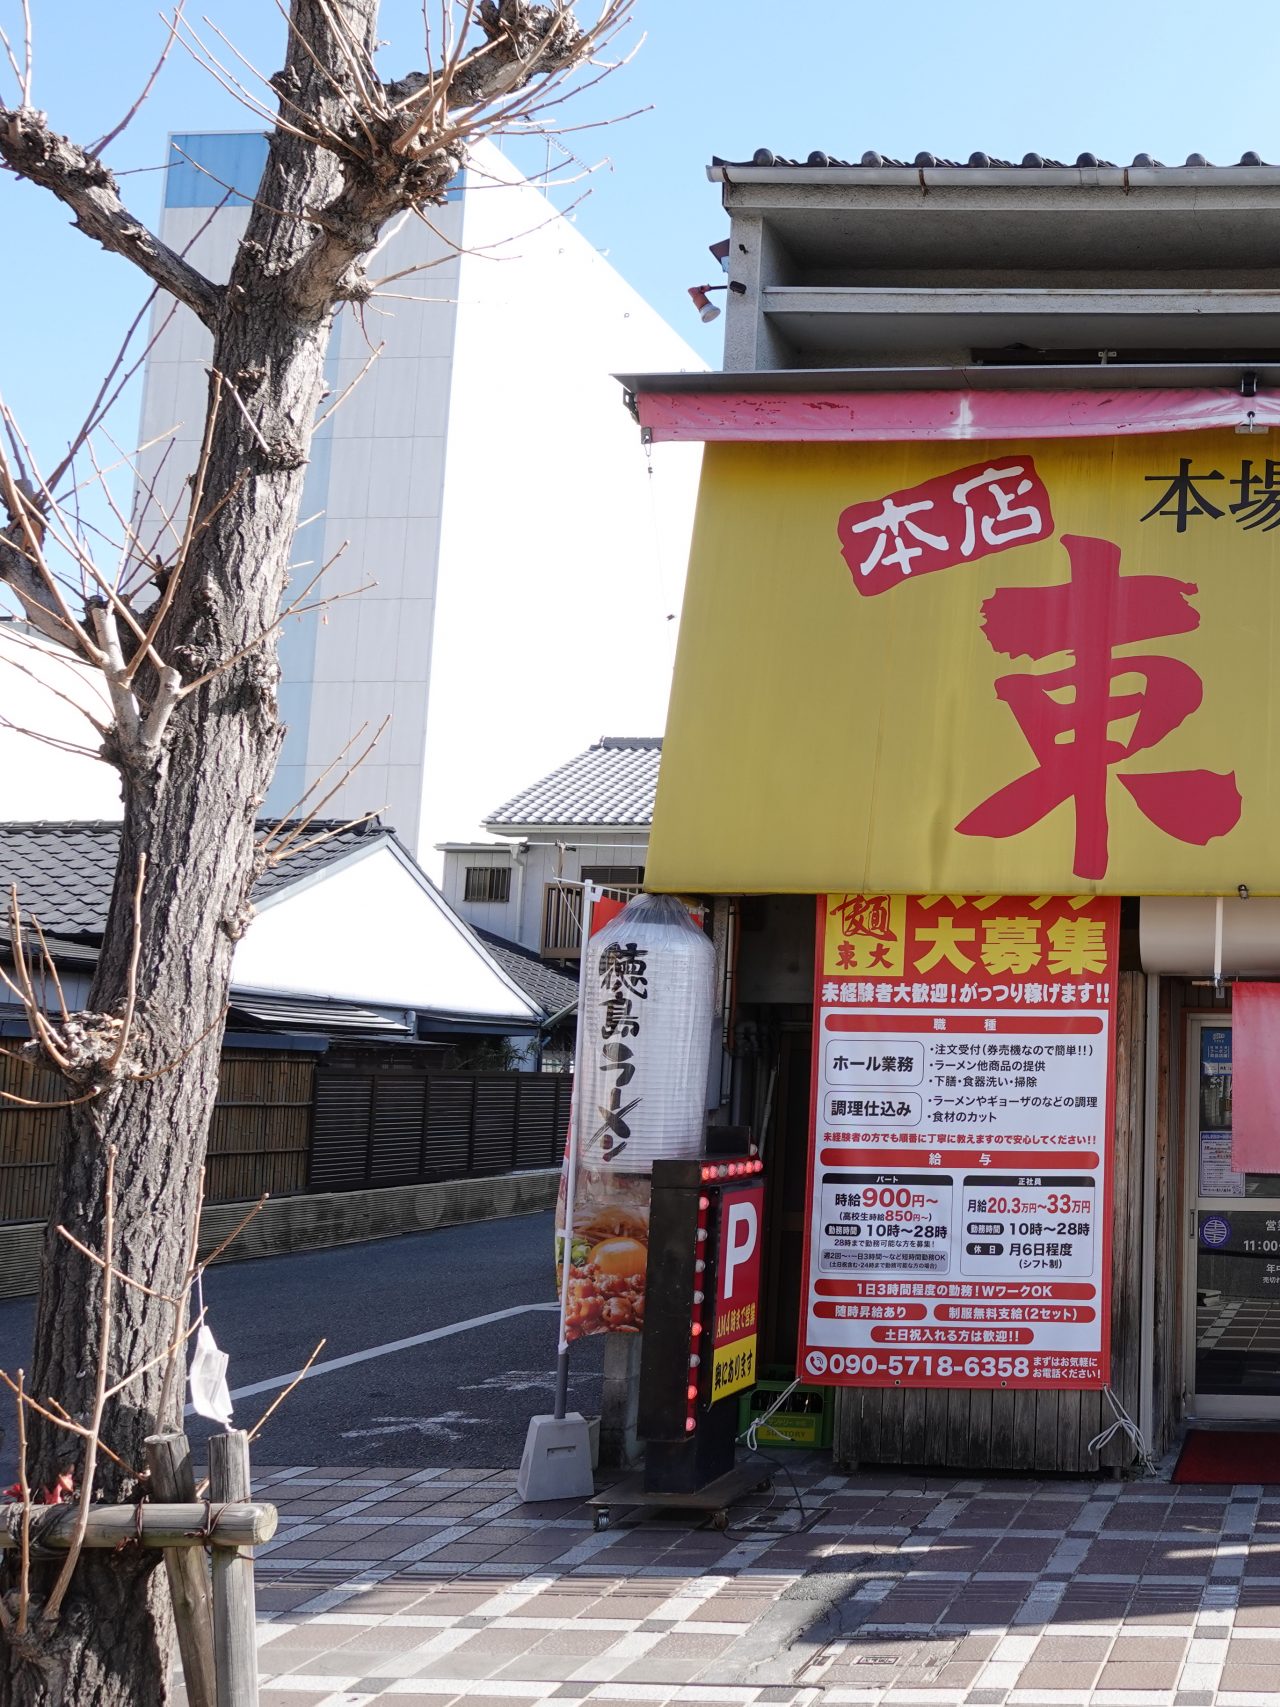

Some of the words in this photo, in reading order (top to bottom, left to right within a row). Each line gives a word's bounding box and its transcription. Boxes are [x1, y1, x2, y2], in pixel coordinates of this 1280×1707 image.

[852, 466, 1042, 575] 本店
[913, 916, 1107, 975] 大募集
[834, 941, 895, 970] 東大
[833, 1055, 913, 1073] ホール業務
[831, 1100, 912, 1117] 調理仕込み
[929, 1153, 991, 1166] 給与
[1018, 1178, 1042, 1186] 正社員
[828, 1226, 858, 1235] 勤務時間
[968, 1224, 1001, 1234] 勤務時間
[724, 1202, 757, 1300] P
[1009, 1243, 1073, 1257] 月6日程度
[1019, 1259, 1062, 1270] (シフト制)
[835, 1305, 906, 1318] 随時昇給あり
[830, 1354, 1029, 1378] 090-5718-6358
[1033, 1357, 1098, 1367] まずはお気軽に
[715, 1348, 753, 1391] 奥にあります
[1032, 1368, 1101, 1379] お電話ください!
